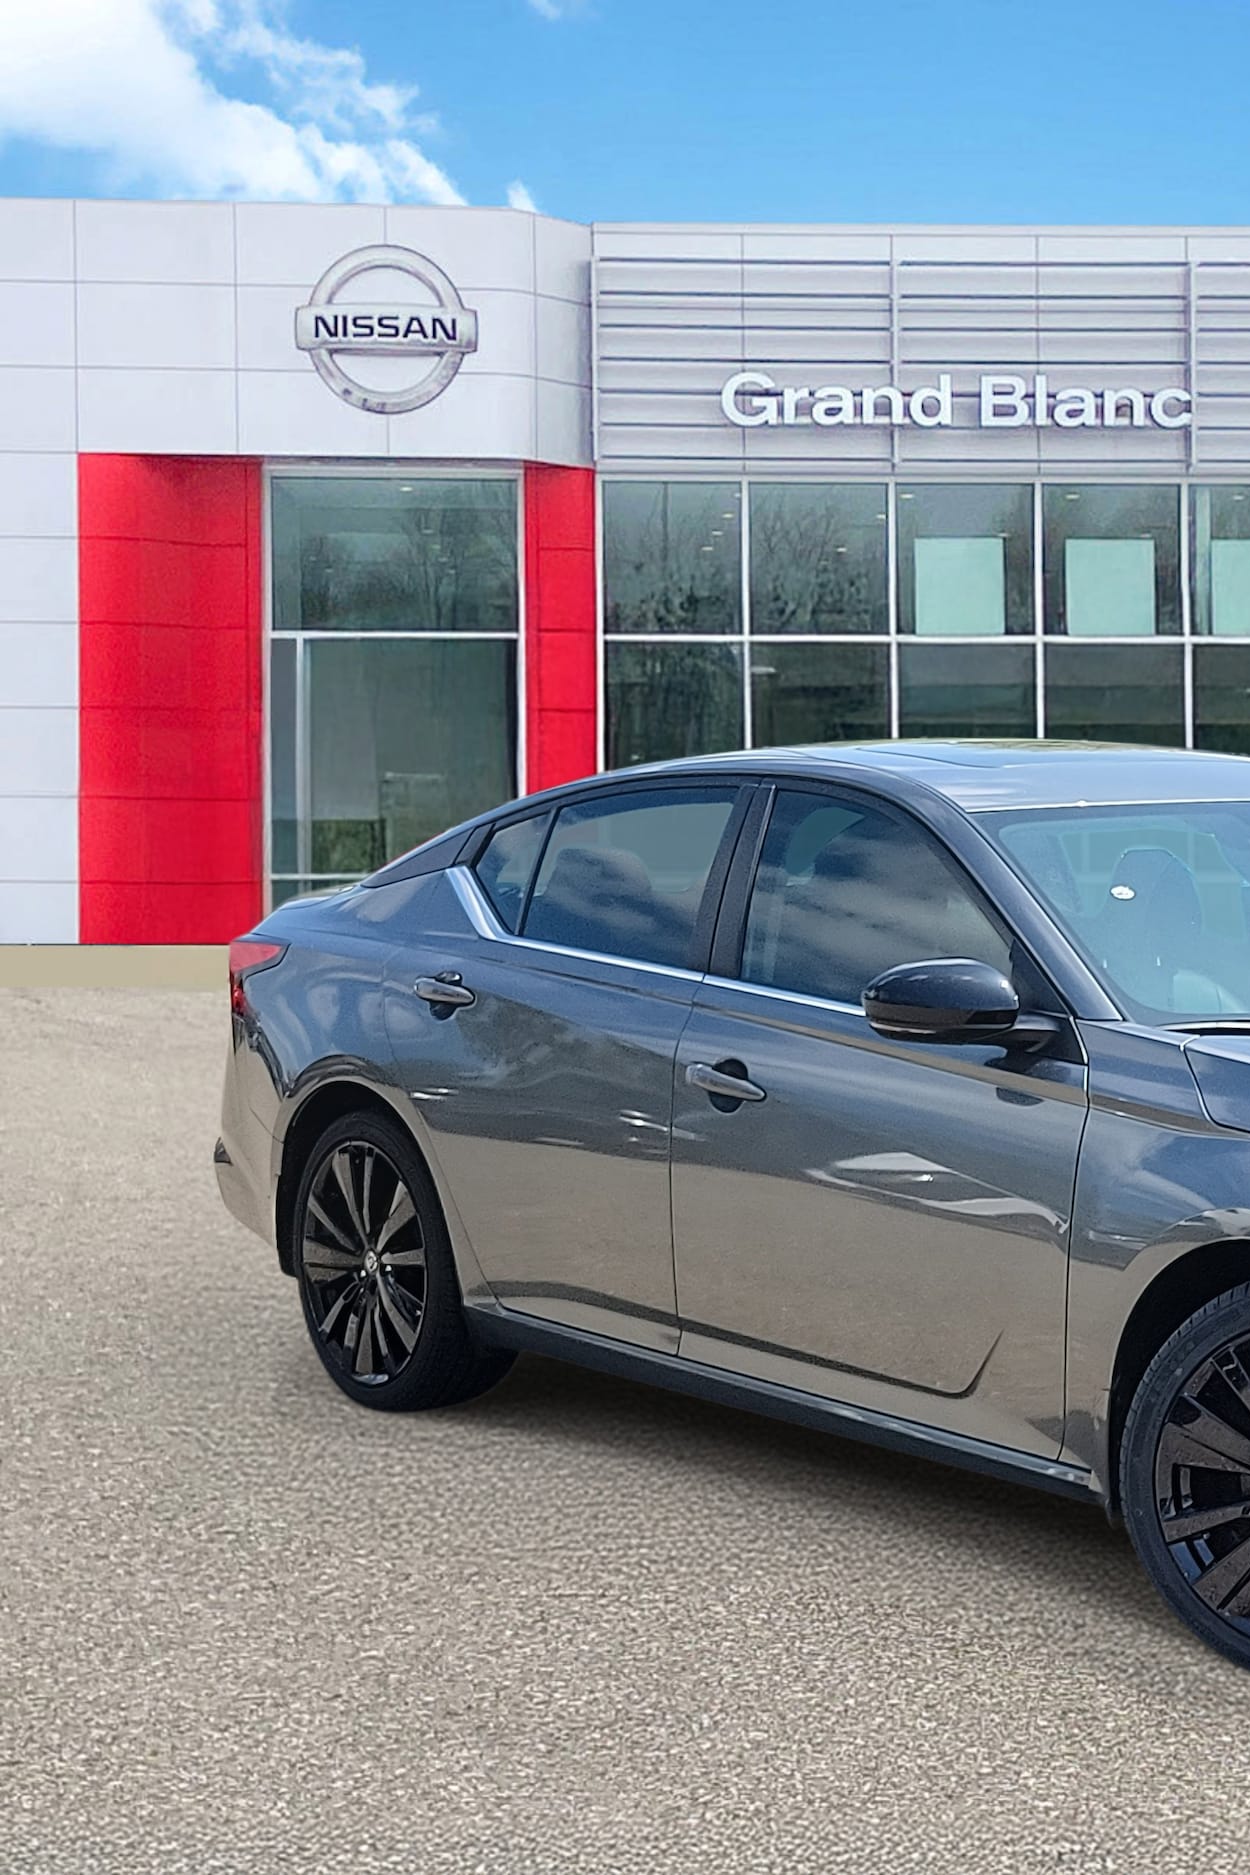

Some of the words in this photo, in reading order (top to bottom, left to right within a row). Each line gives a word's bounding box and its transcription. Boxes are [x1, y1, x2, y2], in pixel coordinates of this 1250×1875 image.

[314, 315, 457, 341] NISSAN
[720, 371, 952, 428] Grand
[979, 374, 1194, 429] Blanc
